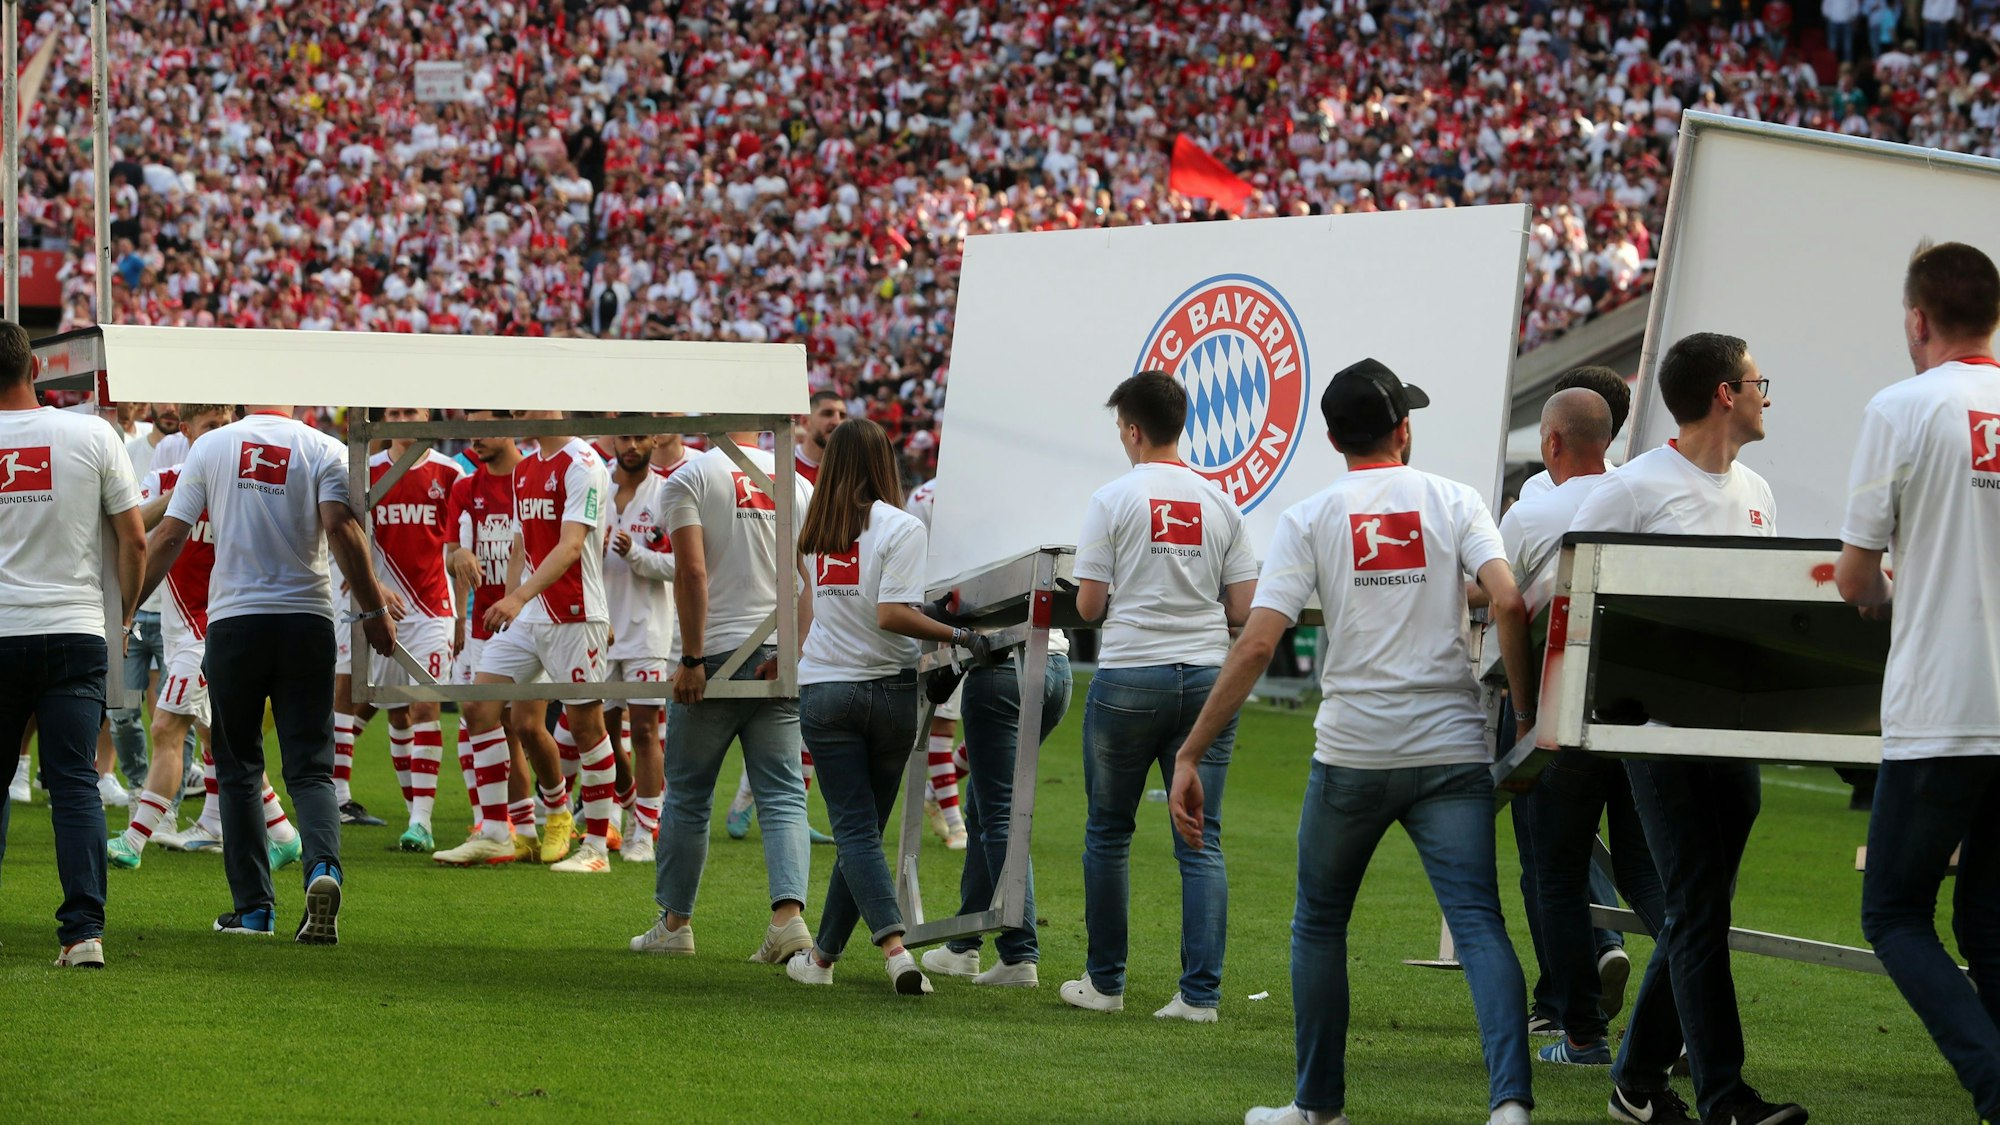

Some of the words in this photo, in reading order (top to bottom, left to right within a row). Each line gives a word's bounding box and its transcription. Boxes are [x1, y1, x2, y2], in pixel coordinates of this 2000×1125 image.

[1187, 292, 1296, 381] BAYERN
[0, 494, 53, 504] BUNDESLIGA
[237, 482, 286, 496] BUNDESLIGA
[376, 503, 437, 526] REWE
[519, 498, 557, 521] EWE
[736, 511, 776, 521] BUNDESLIG
[476, 540, 514, 560] DANK
[1151, 546, 1202, 558] BUNDESLIGA
[1354, 573, 1427, 587] BUNDESLIGA
[428, 652, 441, 679] 8
[165, 674, 189, 706] 11
